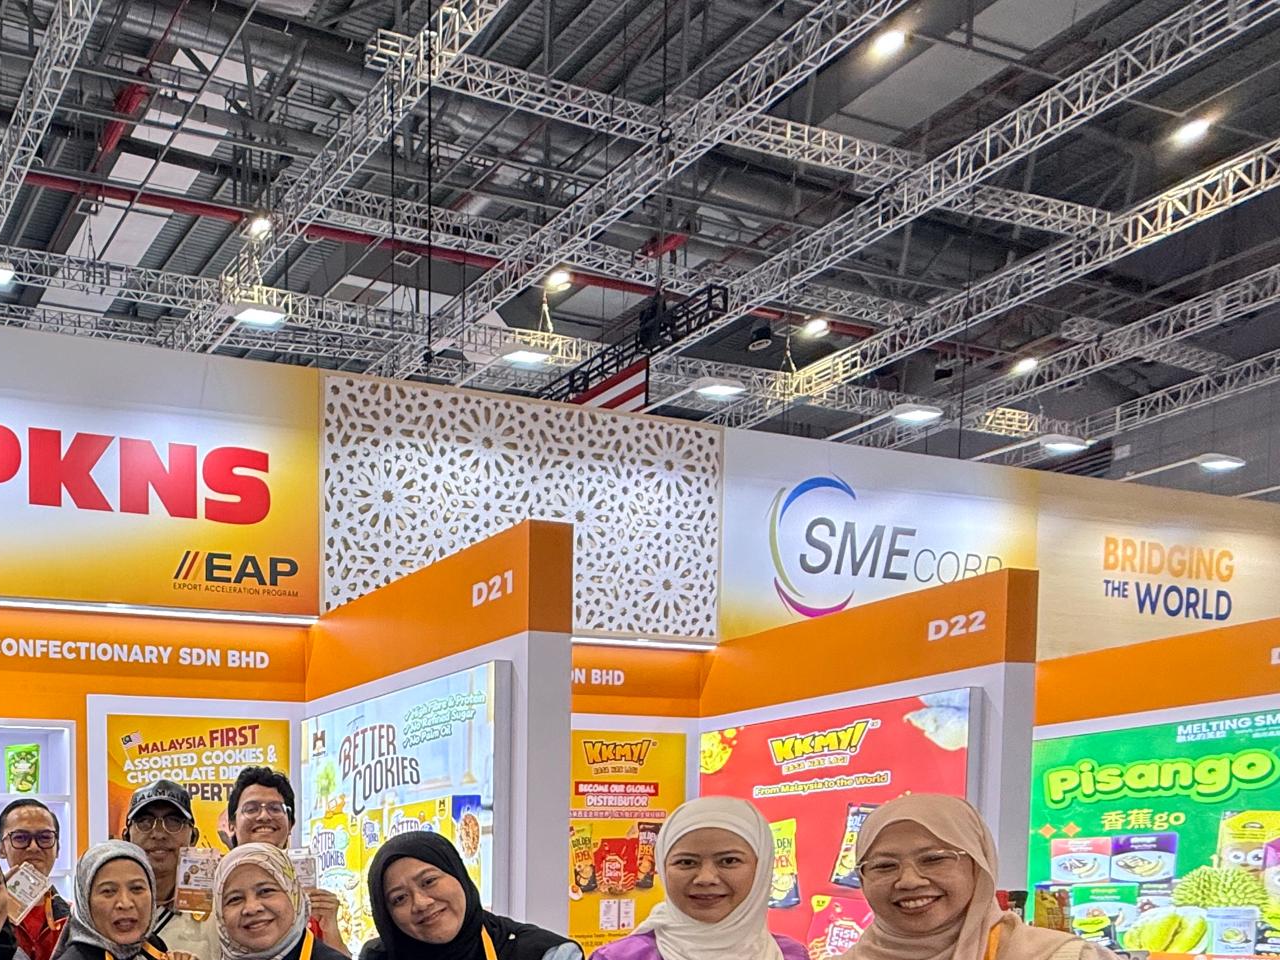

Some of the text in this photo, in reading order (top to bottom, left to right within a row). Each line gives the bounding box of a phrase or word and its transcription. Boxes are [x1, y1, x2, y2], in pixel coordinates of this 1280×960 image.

[1103, 536, 1234, 583] BRIDGING
[173, 582, 299, 597] EXPORT ACCELERATION PROGRAM
[472, 570, 514, 608] D21
[1103, 579, 1232, 621] THE WORLD
[927, 610, 986, 642] D22
[178, 647, 221, 667] SDN
[227, 650, 270, 669] BHD
[590, 669, 625, 686] BHD
[1177, 717, 1252, 735] MELTING
[138, 724, 260, 755] MALAYSIA FIRST
[339, 724, 397, 781] BETTER
[583, 739, 651, 765] KKMY!
[770, 719, 870, 764] KKMY!
[123, 744, 278, 772] ASSORTED COOKIES &
[126, 766, 216, 784] CHOCOLATE
[352, 756, 420, 816] COOKIES
[754, 773, 888, 796] From Malaysia to the World
[578, 784, 656, 793] BECOME OUR GLOBAL
[586, 794, 648, 806] DISTRIBUTOR
[832, 926, 858, 939] Fish
